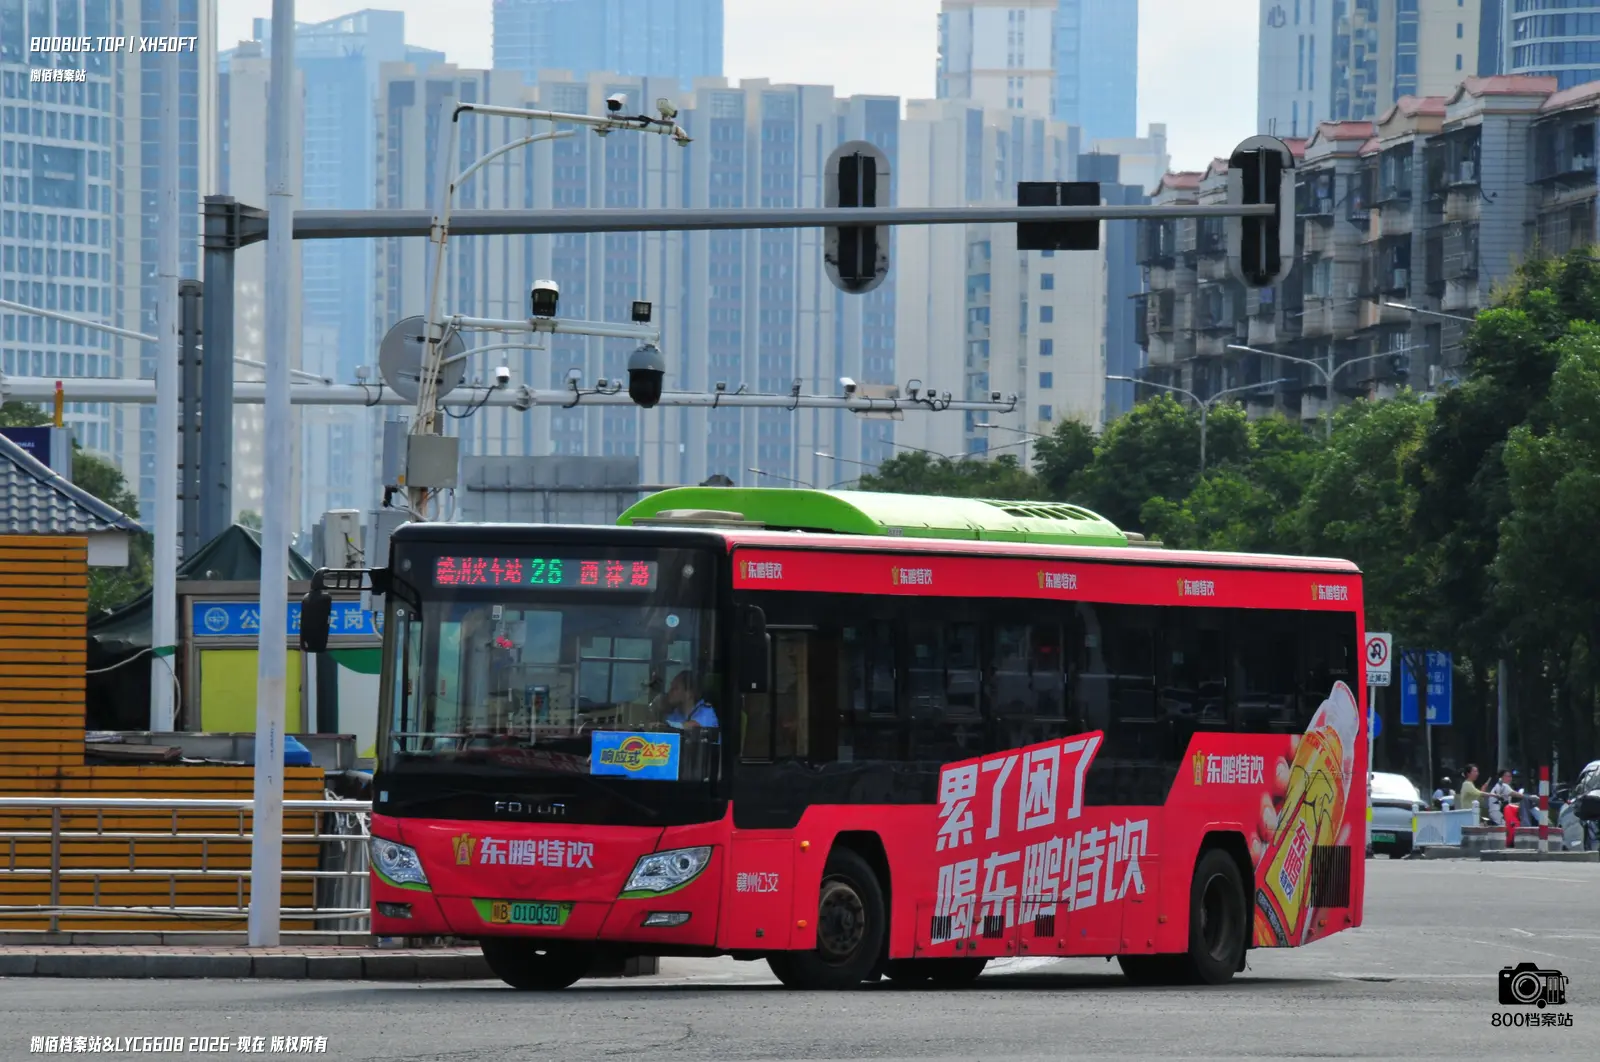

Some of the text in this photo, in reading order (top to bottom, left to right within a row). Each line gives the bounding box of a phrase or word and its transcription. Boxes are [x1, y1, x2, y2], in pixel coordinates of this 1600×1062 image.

[530, 558, 563, 584] 26
[1207, 753, 1264, 784] 东鹏特饮
[936, 735, 1101, 852] 累了困了
[480, 836, 594, 868] 东鹏特饮
[736, 872, 779, 892] 赣州公交
[931, 818, 1149, 945] 喝东鹏特饮
